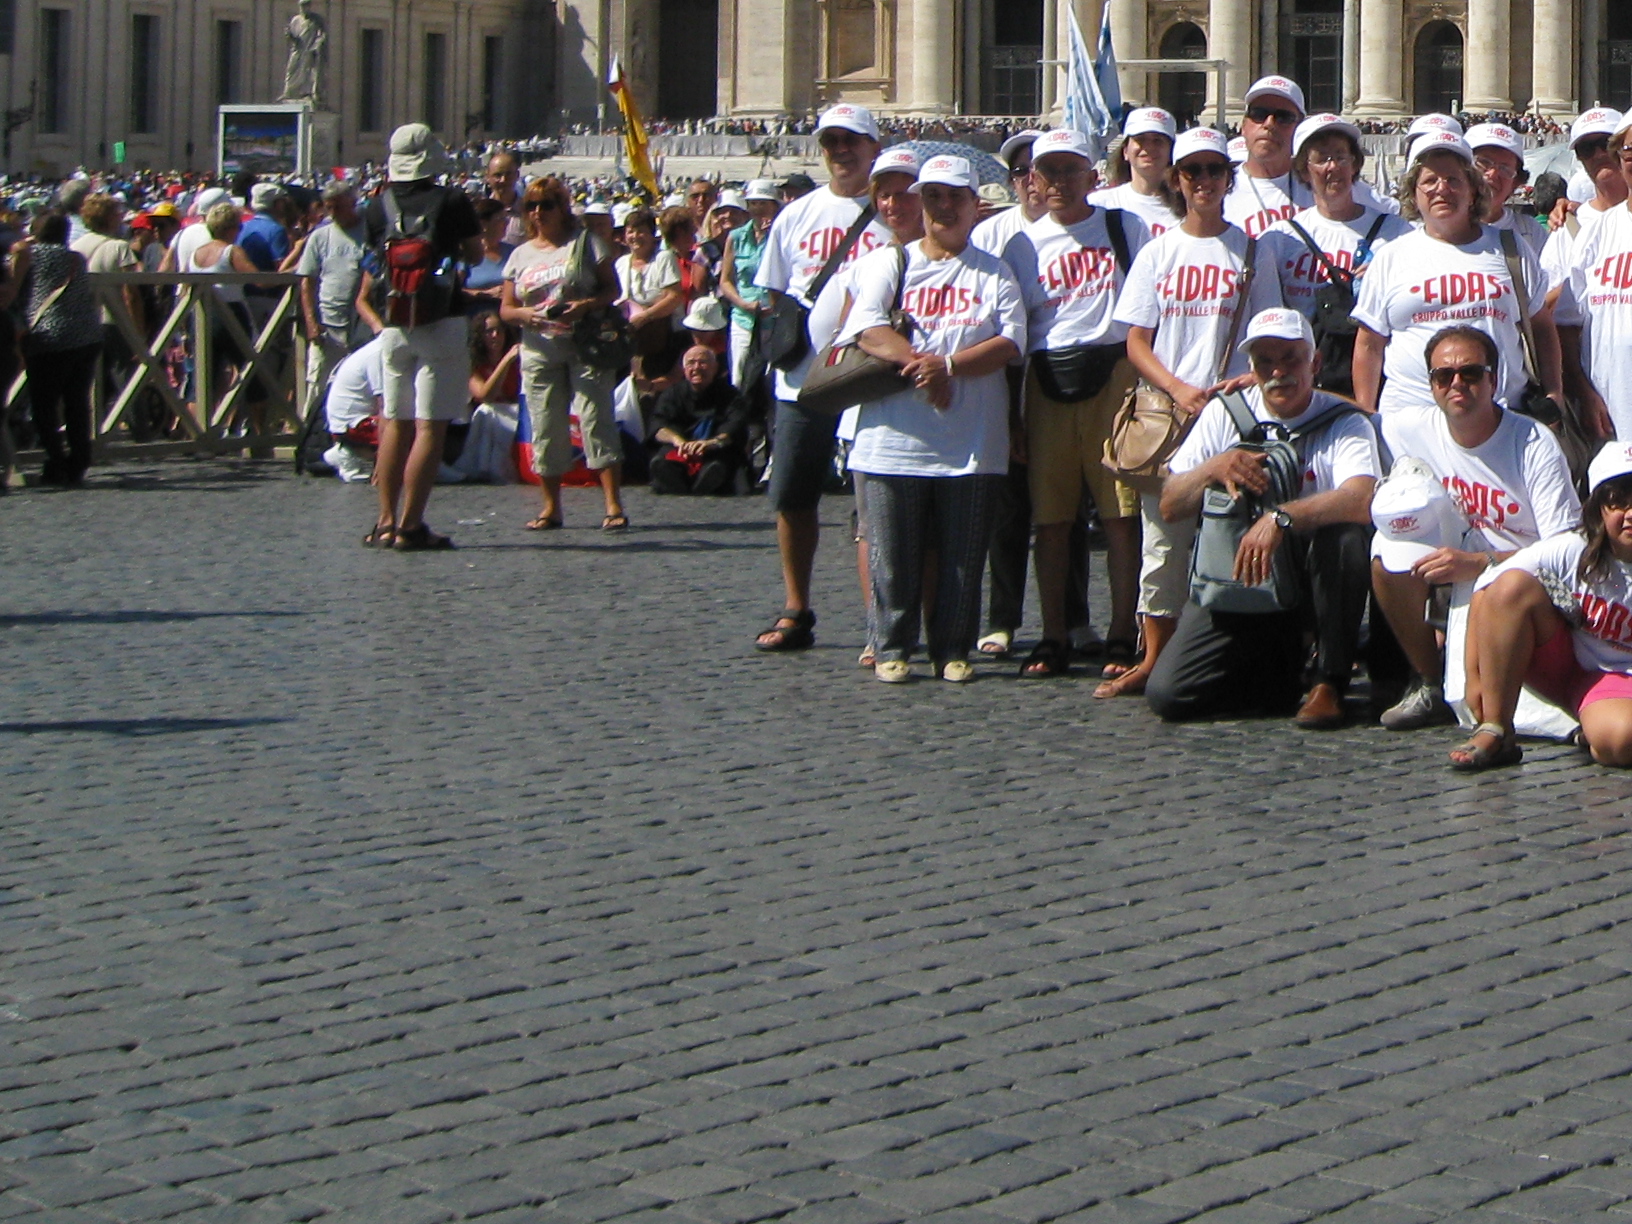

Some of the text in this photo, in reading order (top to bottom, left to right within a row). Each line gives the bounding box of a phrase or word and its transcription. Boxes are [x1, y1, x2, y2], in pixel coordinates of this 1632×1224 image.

[1244, 205, 1306, 240] FIDA
[1047, 246, 1116, 291] FIDAS
[1163, 264, 1237, 303] FIDAS
[1294, 250, 1354, 285] FIDA
[903, 283, 971, 318] FIDAS
[1424, 272, 1503, 307] FIDAS
[1412, 313, 1447, 324] GRUPPO
[1450, 309, 1477, 321] VALLE
